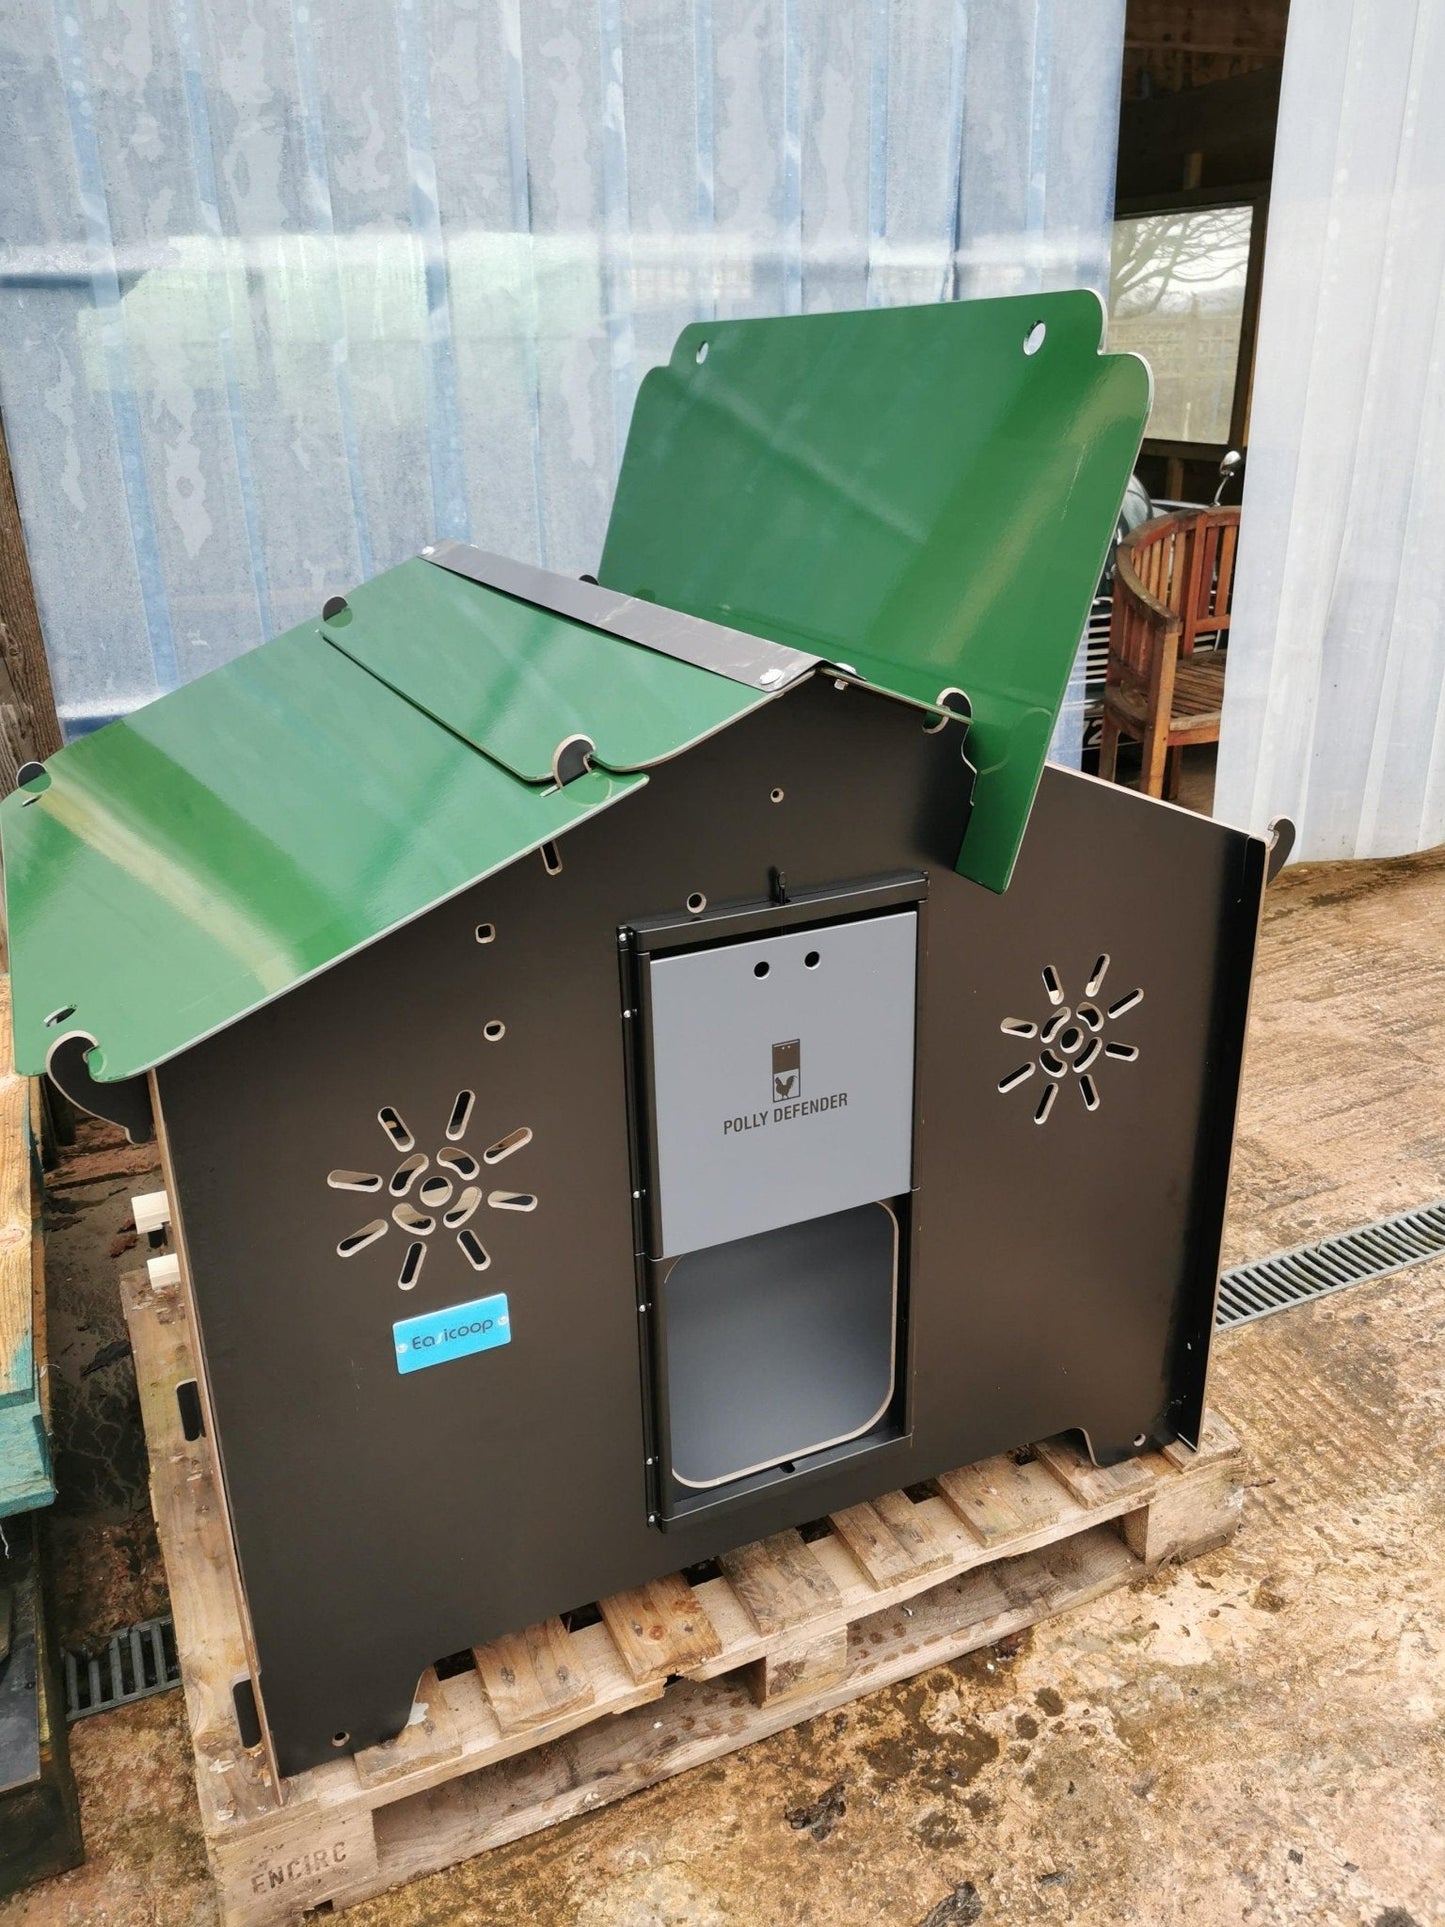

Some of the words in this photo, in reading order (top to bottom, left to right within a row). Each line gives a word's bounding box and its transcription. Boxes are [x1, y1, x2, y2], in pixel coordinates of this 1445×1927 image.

[723, 1110, 769, 1135] POLLY
[773, 1092, 848, 1123] DEFENDER
[251, 1841, 347, 1895] ENCIRC
